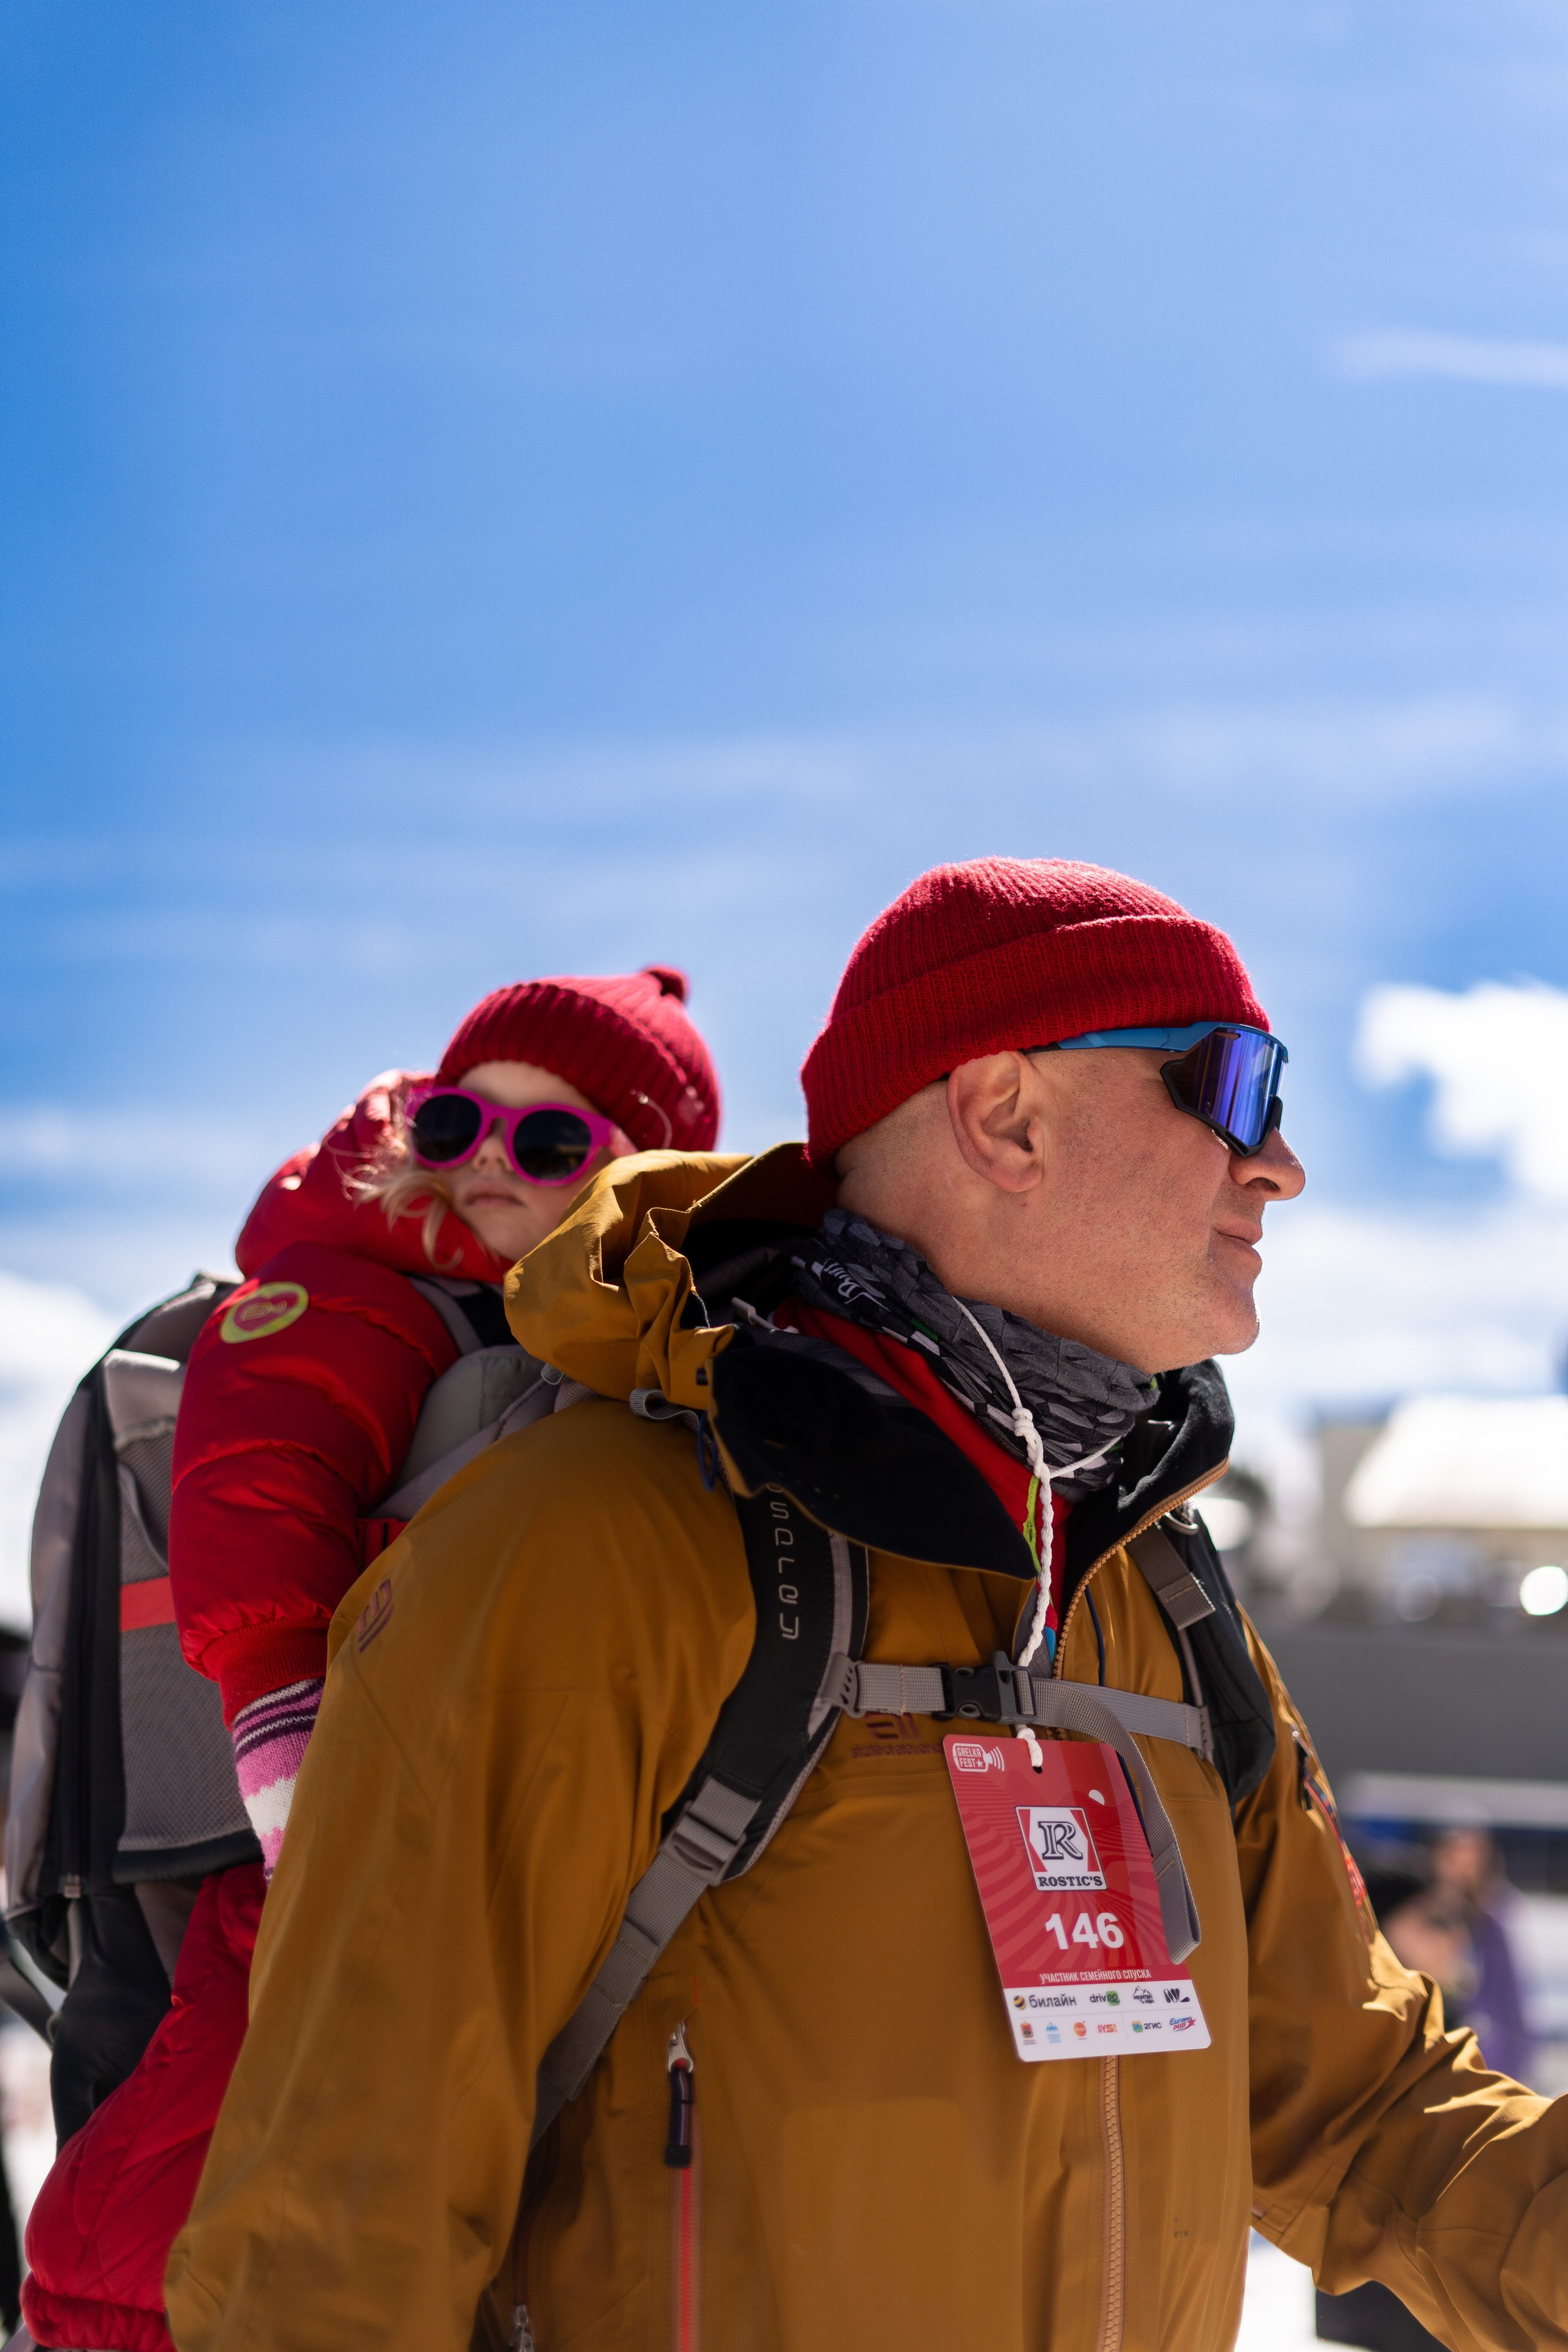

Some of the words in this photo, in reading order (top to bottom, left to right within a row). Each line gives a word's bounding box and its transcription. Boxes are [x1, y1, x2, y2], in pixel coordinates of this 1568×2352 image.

[956, 1747, 982, 1758] GRELKA
[959, 1757, 976, 1768] FEST
[1038, 1821, 1084, 1860] R
[1038, 1875, 1103, 1887] ROSTIC'S
[1045, 1912, 1125, 1950] 146
[1039, 1972, 1079, 1985] УЧАСТНИК
[1080, 1969, 1122, 1981] СЕМЕЙНОГО
[1122, 1969, 1152, 1980] СПУСКА
[1029, 1993, 1077, 2008] билайн
